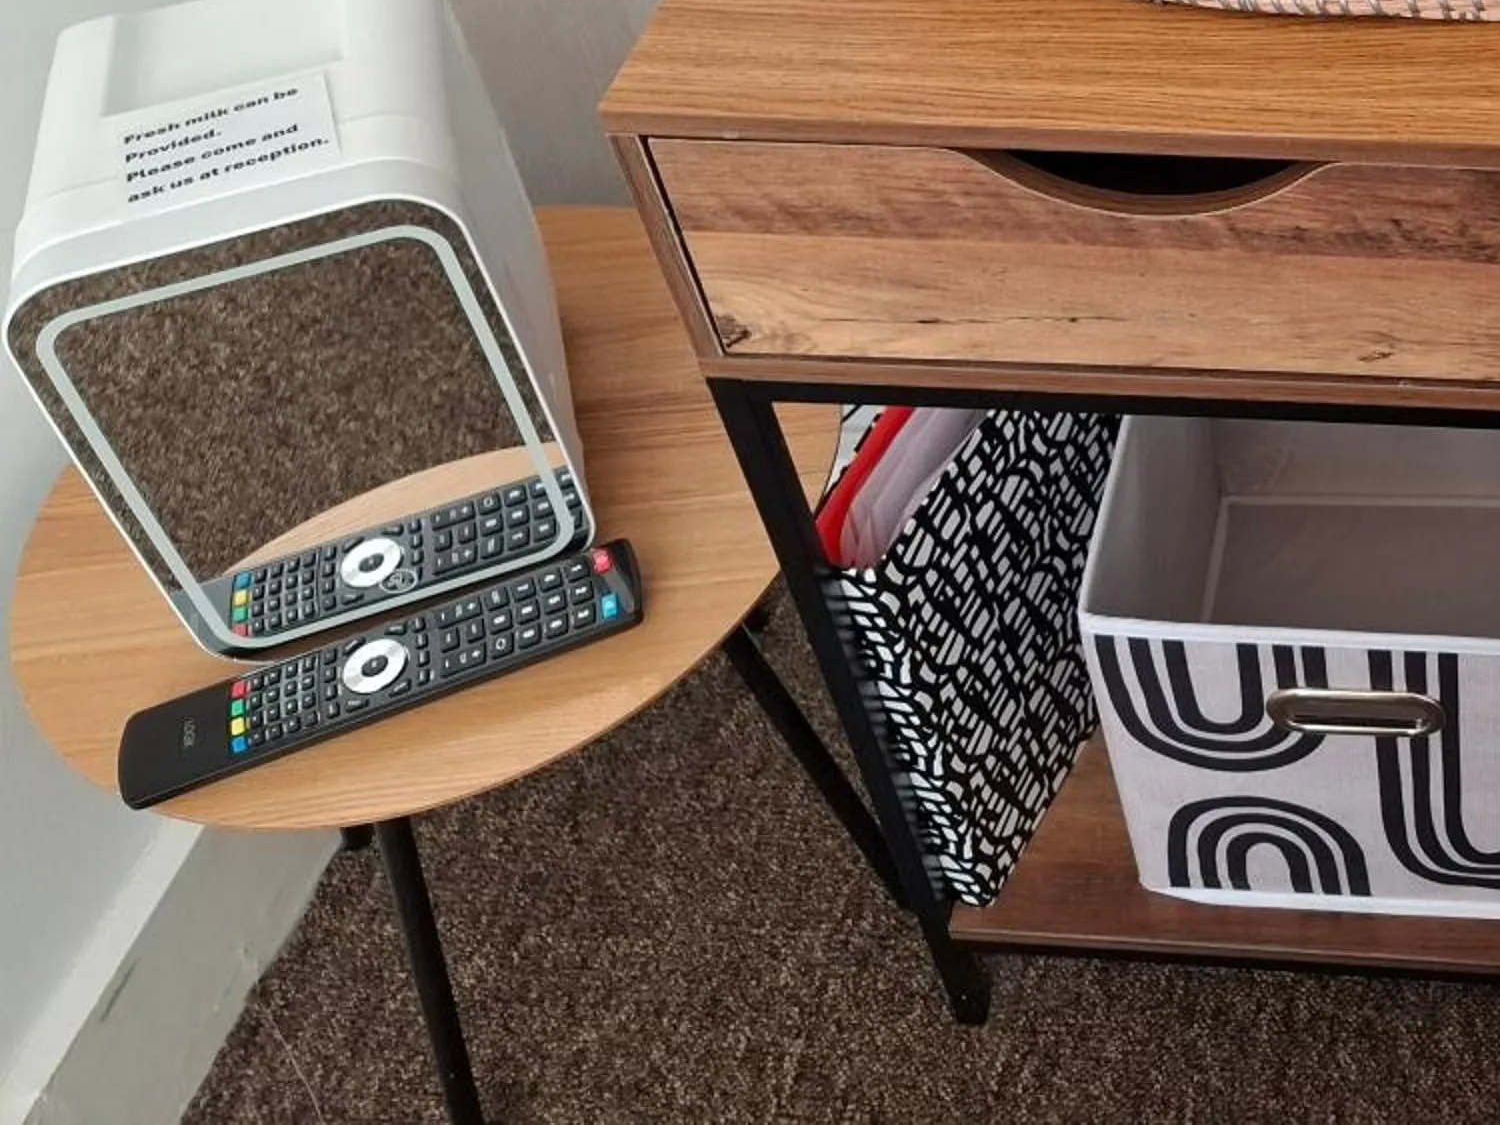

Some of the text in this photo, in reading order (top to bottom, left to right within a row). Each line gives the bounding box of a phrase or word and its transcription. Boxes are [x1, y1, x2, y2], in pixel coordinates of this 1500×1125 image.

[124, 88, 299, 145] Fresh milk can be
[126, 123, 299, 183] Please come and
[127, 185, 164, 204] ask
[169, 176, 195, 191] us
[199, 167, 220, 181] at
